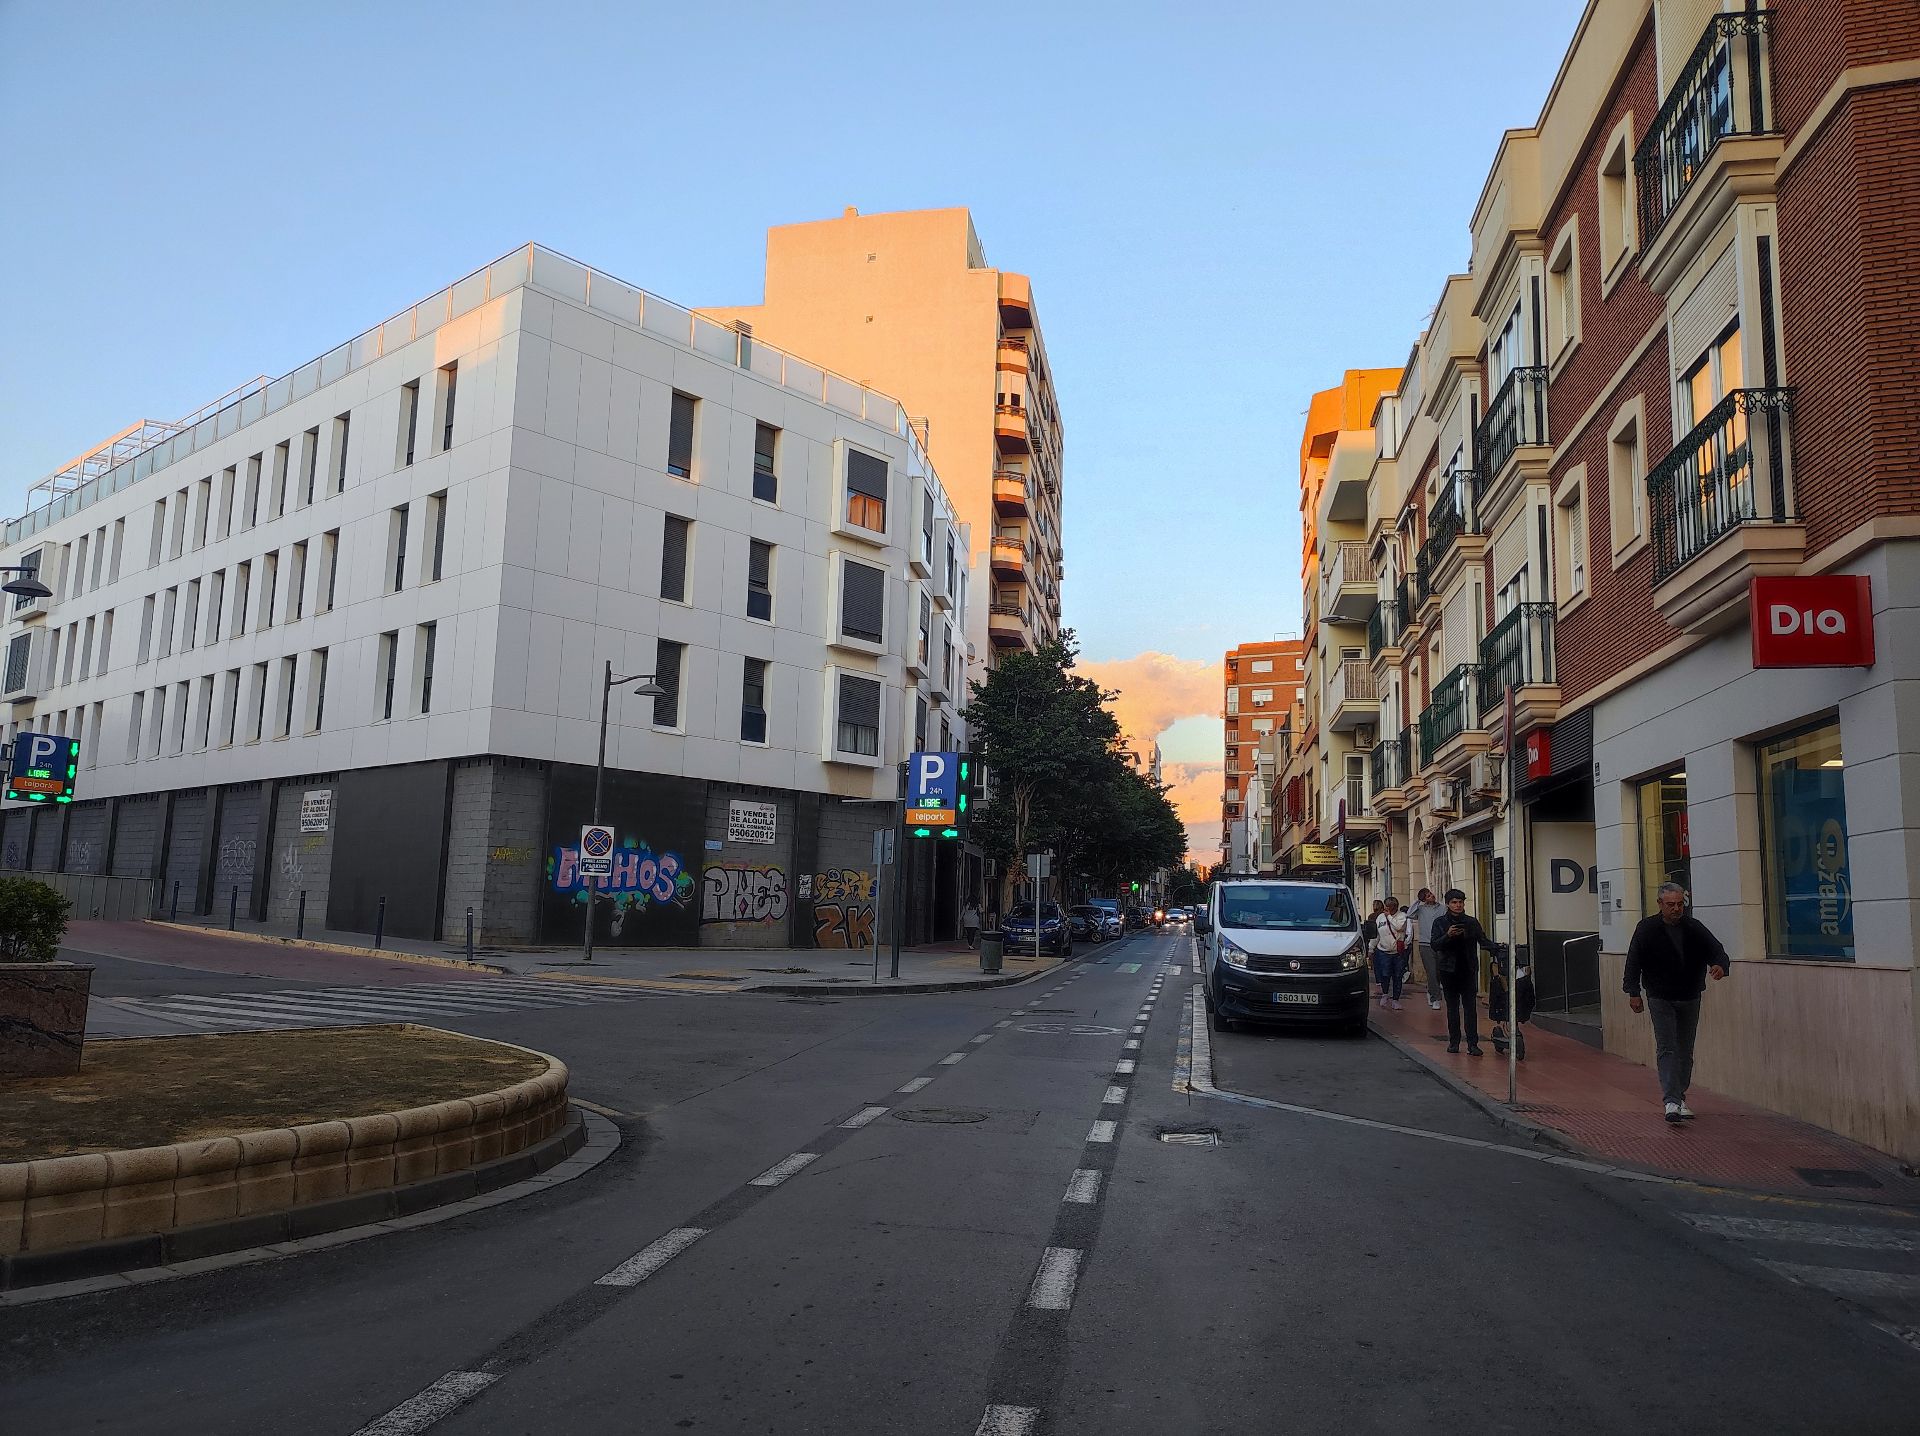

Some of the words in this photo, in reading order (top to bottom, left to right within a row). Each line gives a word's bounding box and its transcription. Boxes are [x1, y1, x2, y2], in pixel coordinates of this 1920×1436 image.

[1770, 604, 1846, 635] Dia
[29, 736, 57, 767] P
[1528, 747, 1539, 765] Dia
[28, 769, 51, 779] LIBRE
[920, 755, 945, 795] P
[24, 780, 54, 789] telpark
[929, 787, 943, 795] 24h
[919, 798, 941, 808] LIBRE
[742, 810, 768, 819] VENDE
[915, 812, 945, 822] telpark
[742, 817, 775, 826] ALQUILA
[730, 828, 775, 840] 950620912
[1278, 993, 1299, 1002] 6603
[1300, 994, 1317, 1003] LVC
